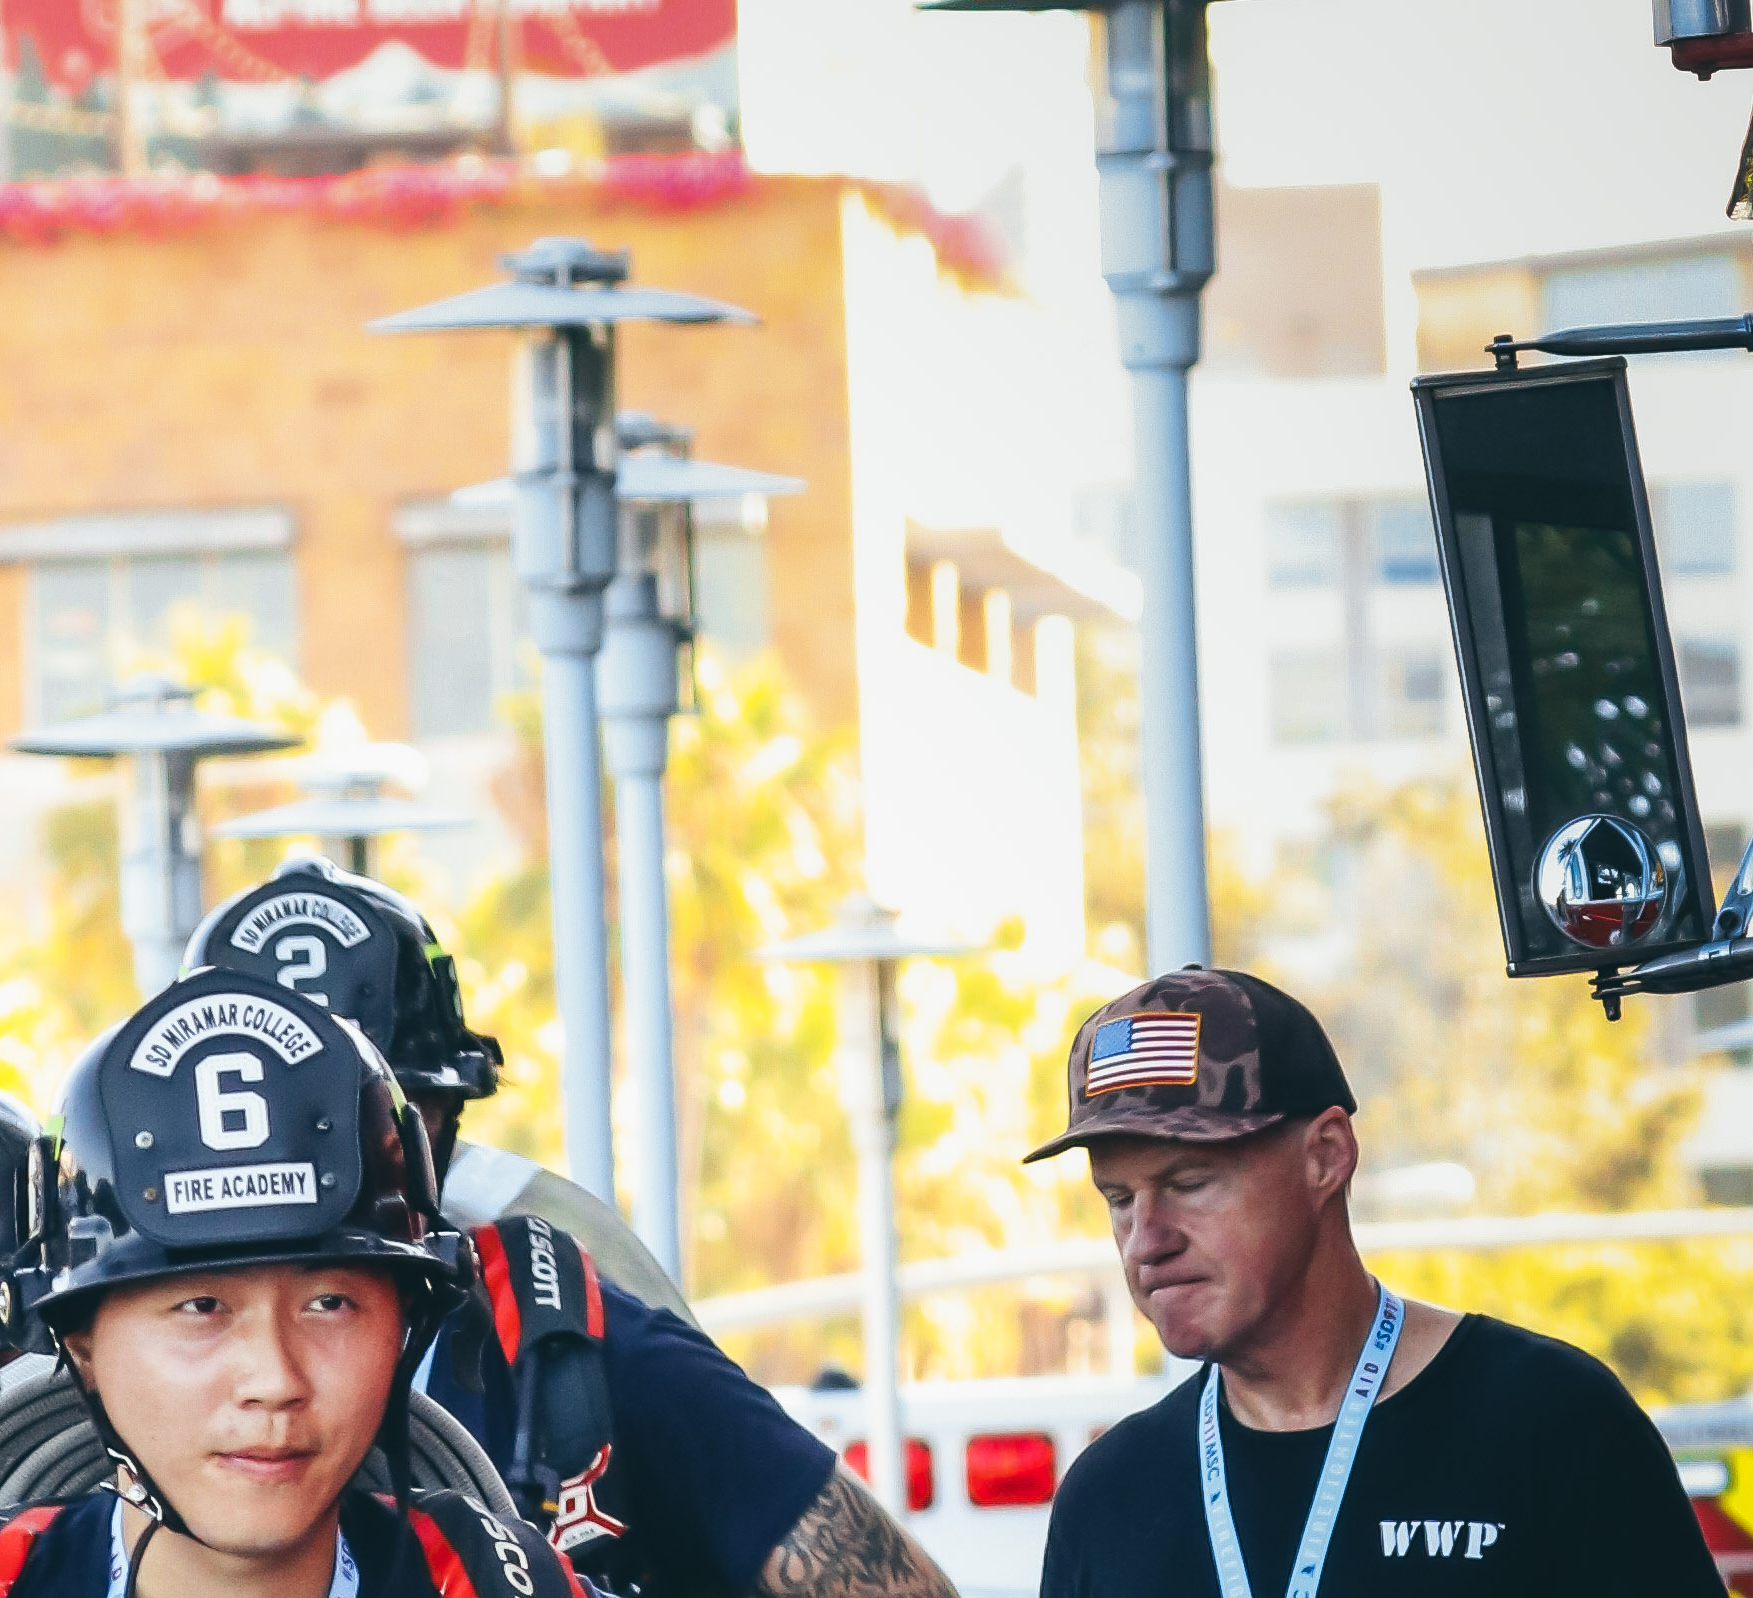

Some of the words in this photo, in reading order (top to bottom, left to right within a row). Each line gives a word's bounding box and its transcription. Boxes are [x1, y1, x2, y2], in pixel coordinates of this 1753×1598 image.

[252, 899, 308, 933] MIRAMAR
[275, 934, 330, 1008] 2
[161, 1003, 238, 1050] MIRAMAR
[243, 1004, 312, 1059] COLLEGE
[195, 1051, 272, 1151] 6
[173, 1177, 214, 1204] FIRE
[221, 1171, 306, 1199] ACADEMY
[529, 1232, 562, 1311] SCOTT
[1355, 1362, 1380, 1398] AID
